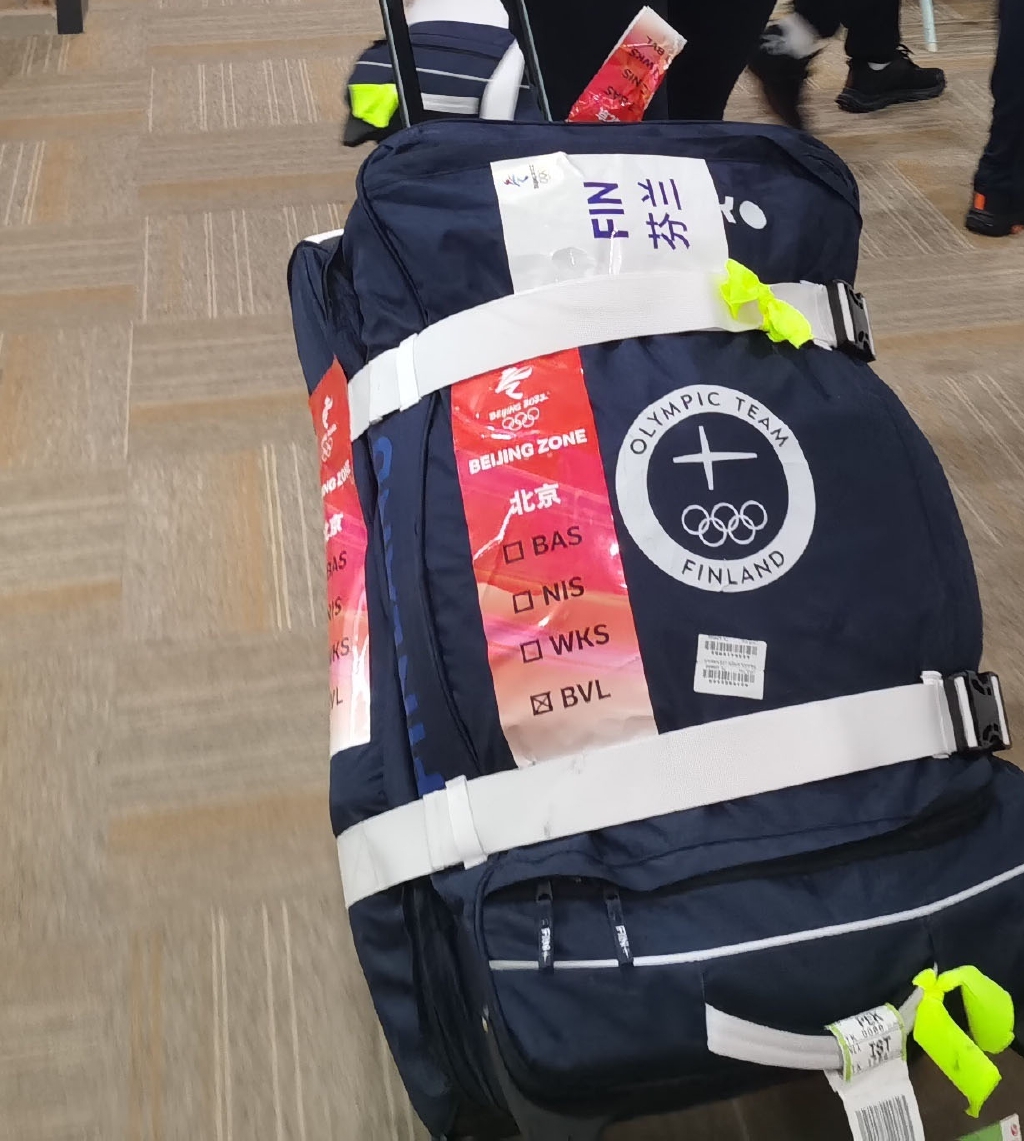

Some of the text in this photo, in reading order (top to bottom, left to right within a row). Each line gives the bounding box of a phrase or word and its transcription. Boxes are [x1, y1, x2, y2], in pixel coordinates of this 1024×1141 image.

[582, 180, 630, 240] FIN
[637, 178, 691, 251] 芬兰
[629, 391, 790, 456] OLYMPIC TEAM
[468, 428, 588, 475] BEIJING ZONE
[508, 483, 562, 516] 北京
[531, 525, 584, 557] BAS
[680, 550, 786, 586] FINLAND
[542, 576, 585, 606] NIS
[329, 637, 350, 664] KS
[549, 623, 611, 657] WKS
[559, 679, 612, 709] BVL
[868, 1035, 892, 1058] IST
